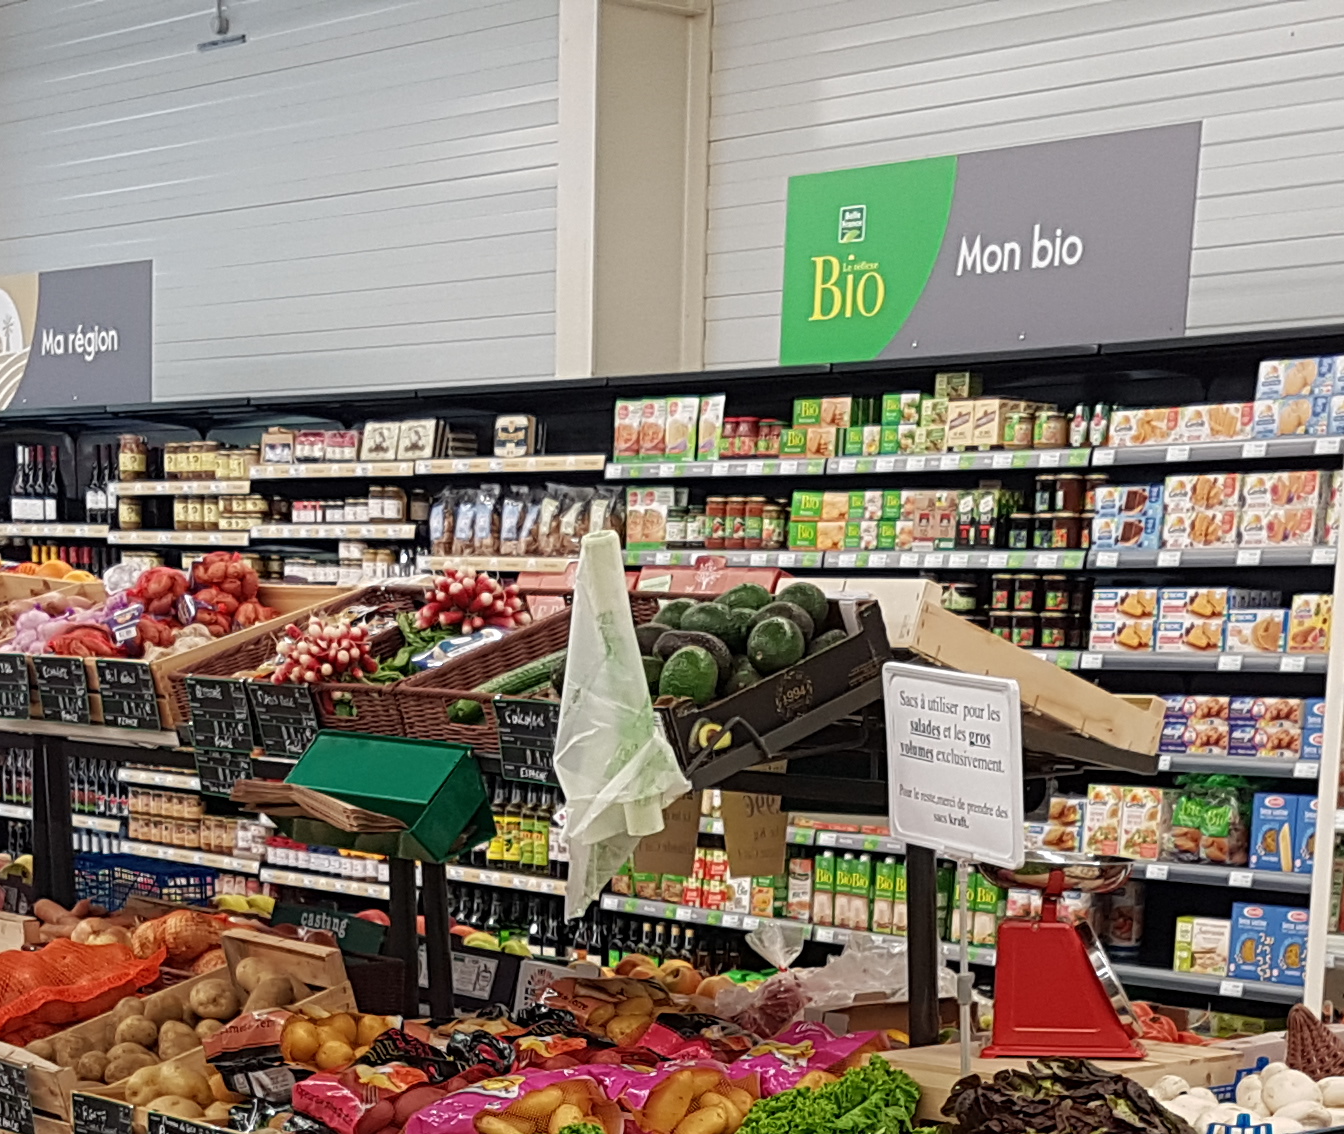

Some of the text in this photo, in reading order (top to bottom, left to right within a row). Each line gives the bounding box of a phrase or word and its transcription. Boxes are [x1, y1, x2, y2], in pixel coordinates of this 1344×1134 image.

[956, 223, 1083, 276] Mon bio
[808, 254, 886, 321] Bio
[41, 324, 118, 362] Ma région
[899, 690, 918, 709] Sacs
[927, 696, 958, 716] utiliser
[963, 705, 986, 721] pour
[987, 703, 1001, 722] les
[910, 717, 991, 747] salades et les gros
[900, 741, 1005, 774] volumes exclusivement.
[899, 784, 912, 799] Pour
[957, 797, 965, 810] de
[967, 800, 994, 816] prendre
[995, 804, 1008, 819] des
[934, 812, 970, 828] sacs kraft.
[817, 869, 833, 884] Bio
[837, 871, 852, 886] Bio
[853, 873, 868, 888] Bio
[877, 875, 894, 890] Bio
[897, 877, 907, 892] Bi
[978, 887, 996, 902] Bio
